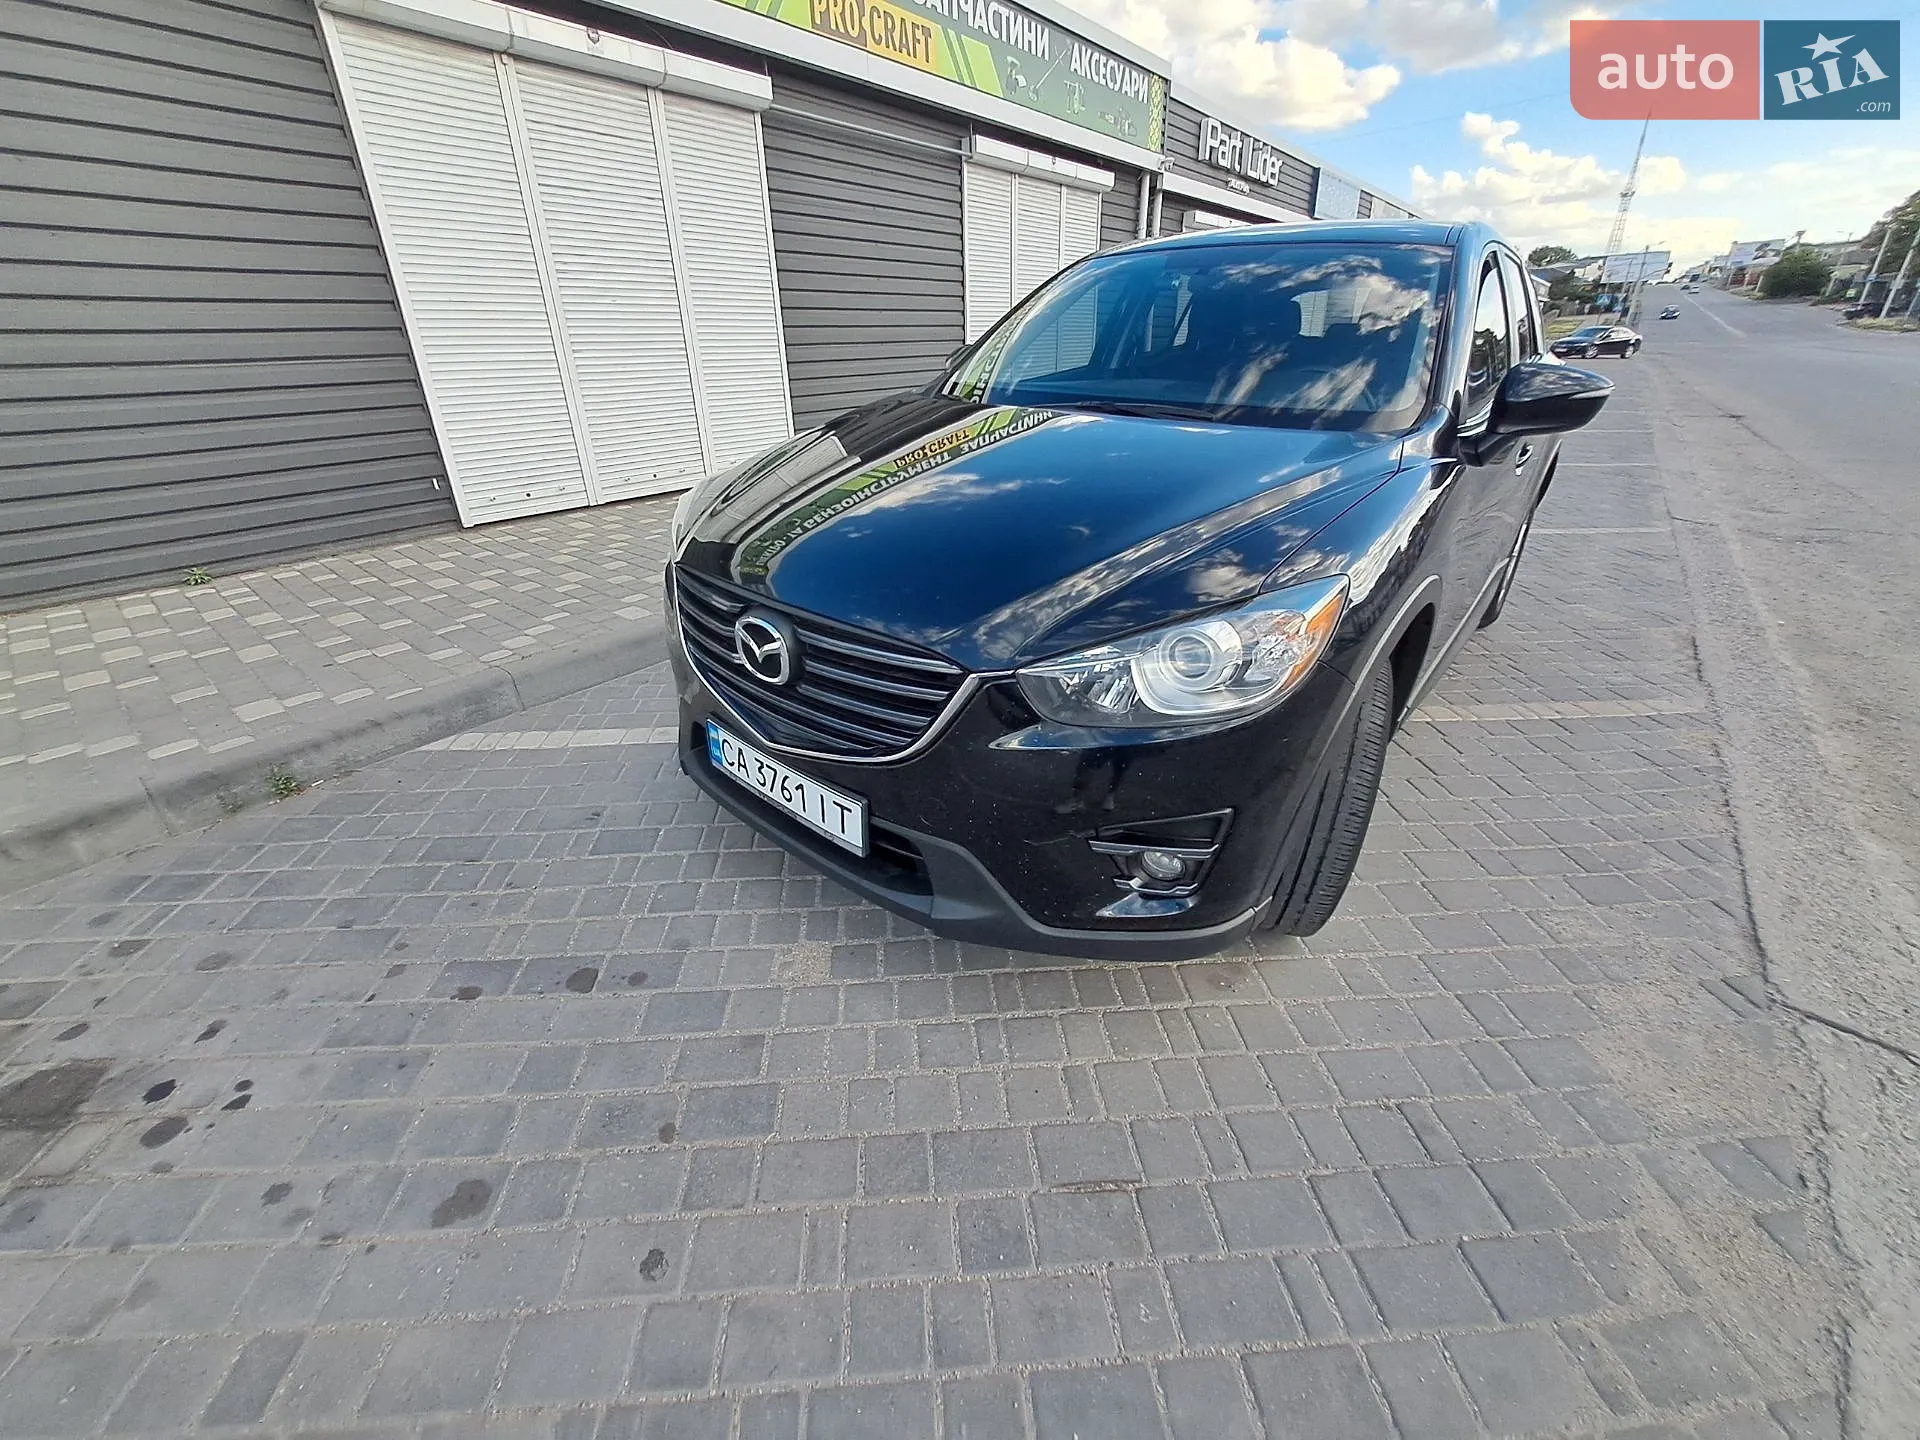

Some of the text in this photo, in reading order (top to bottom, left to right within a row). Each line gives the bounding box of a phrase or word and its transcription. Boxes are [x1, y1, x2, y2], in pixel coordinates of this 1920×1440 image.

[813, 0, 932, 63] PRO CRAFT
[911, 0, 1149, 104] ЧАСТИНИ АКСЕСУАРИ
[1203, 118, 1283, 187] Part Lider
[722, 738, 750, 779] CA
[754, 757, 807, 813] 3761
[820, 793, 853, 835] IT
